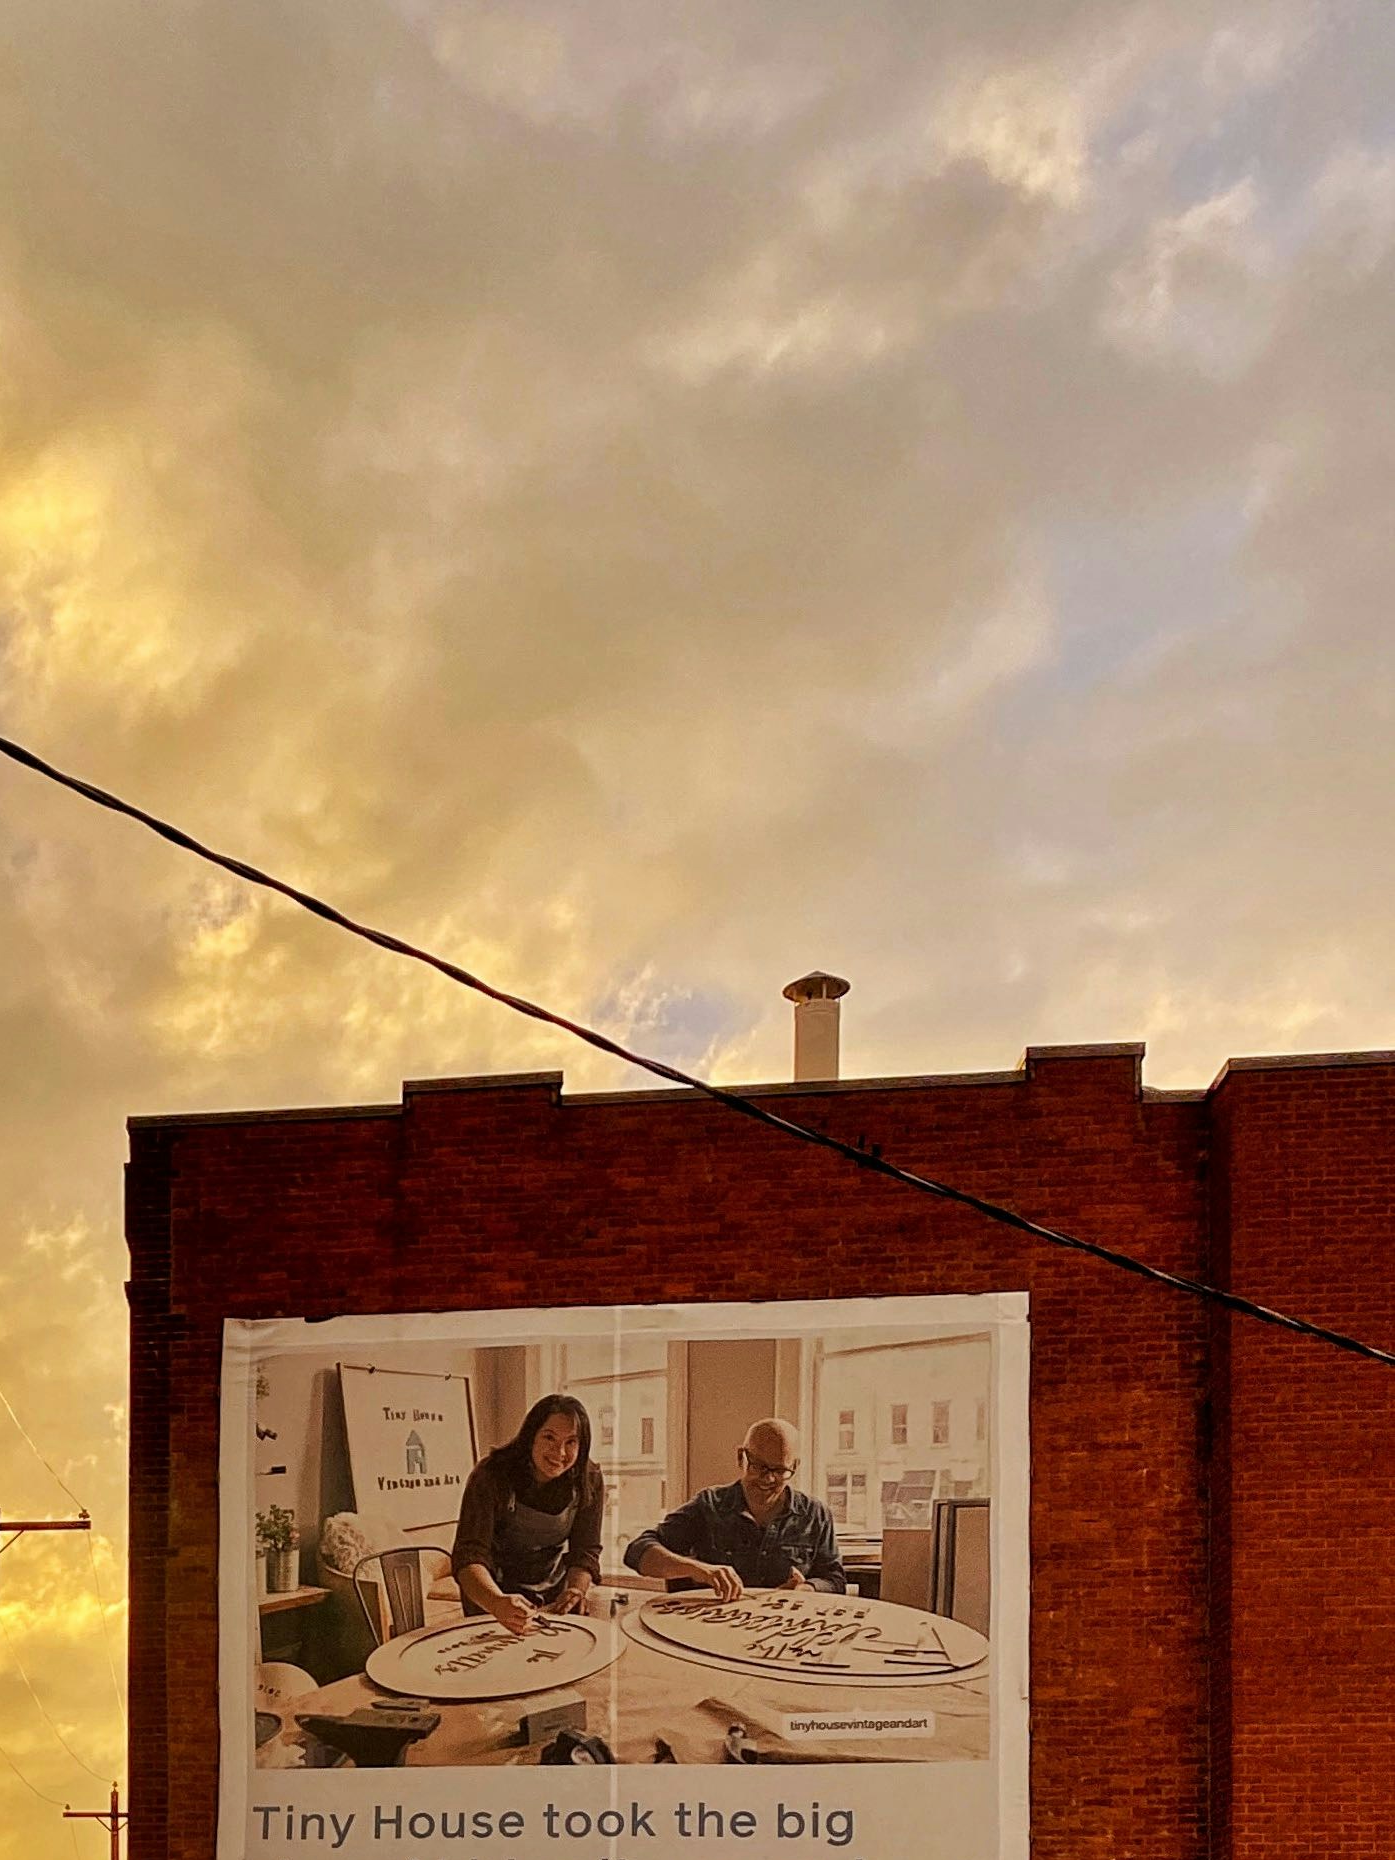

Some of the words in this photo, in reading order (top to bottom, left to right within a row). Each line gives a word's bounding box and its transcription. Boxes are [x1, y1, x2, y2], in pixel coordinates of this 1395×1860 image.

[790, 1718, 928, 1733] tinyhousevintageandart
[252, 1804, 355, 1848] Tiny
[373, 1804, 525, 1840] House
[543, 1802, 656, 1839] took
[674, 1802, 758, 1839] the
[777, 1802, 855, 1847] big
